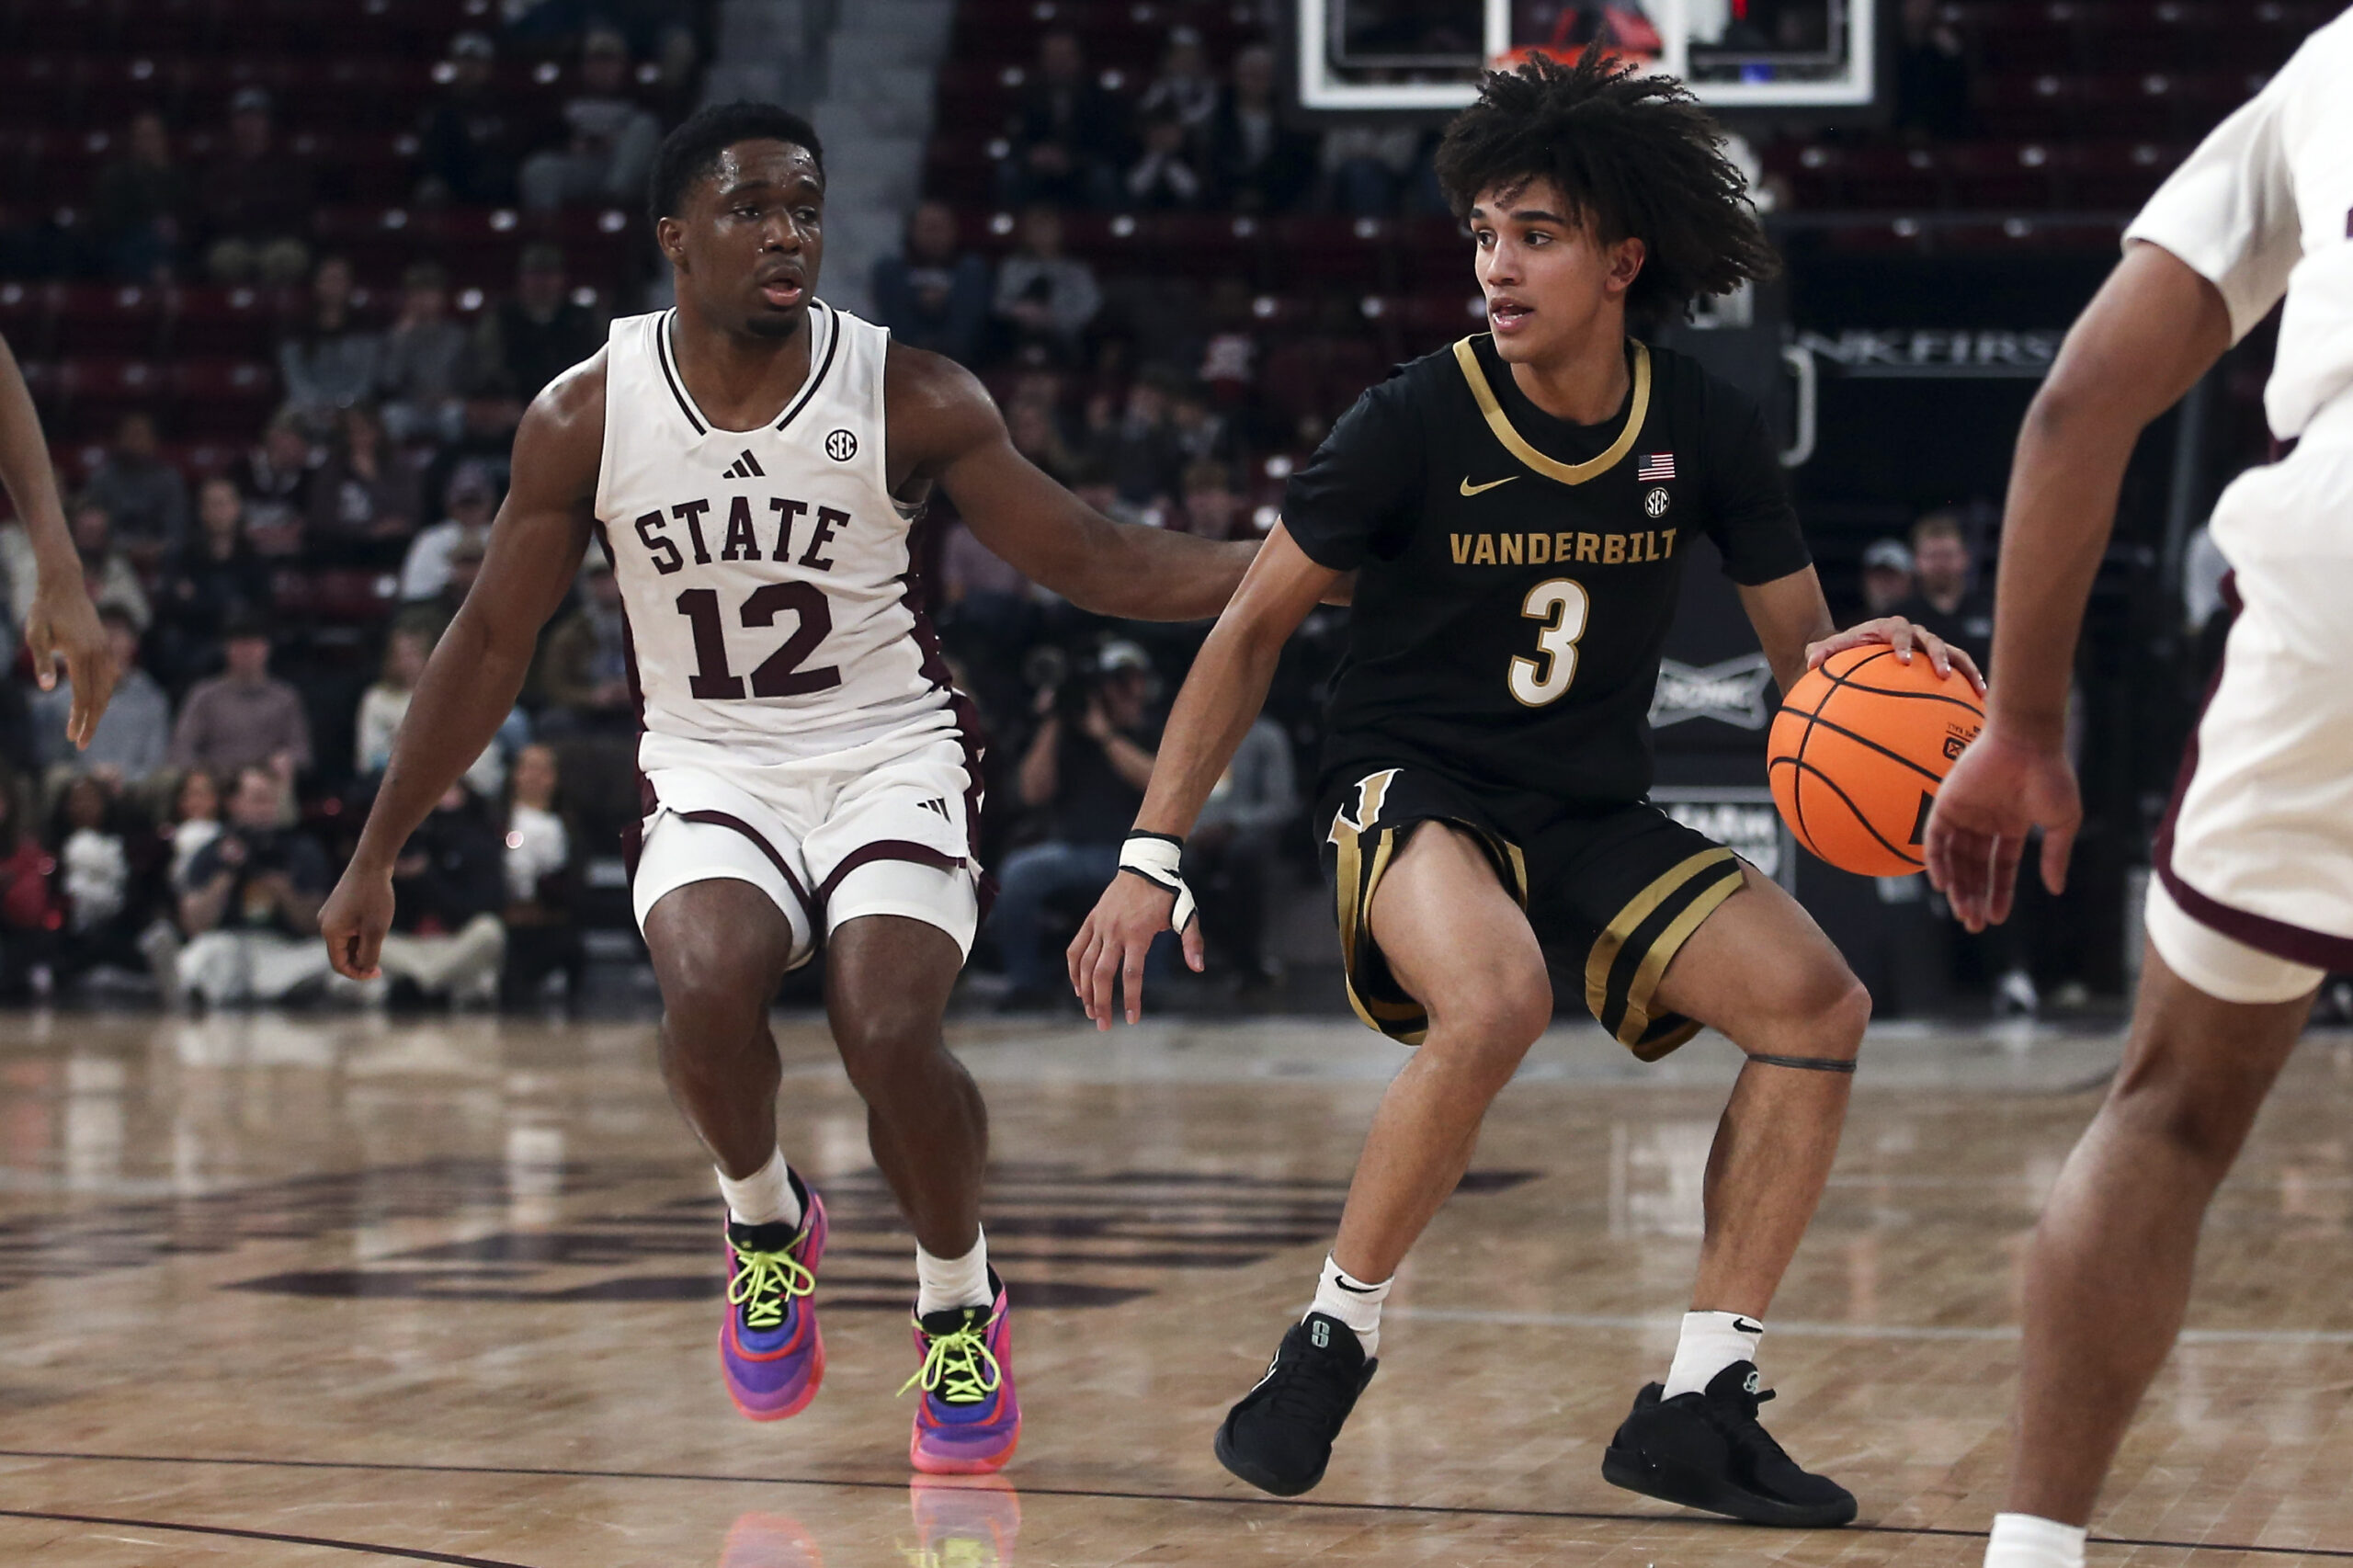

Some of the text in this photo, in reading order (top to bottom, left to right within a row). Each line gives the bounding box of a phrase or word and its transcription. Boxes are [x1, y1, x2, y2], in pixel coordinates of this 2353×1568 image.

[826, 431, 857, 460] SEC
[1647, 489, 1669, 517] SEC
[634, 495, 851, 575] STATE
[1449, 528, 1677, 565] VANDERBILT
[676, 580, 842, 700] 12
[1507, 577, 1590, 708] 3
